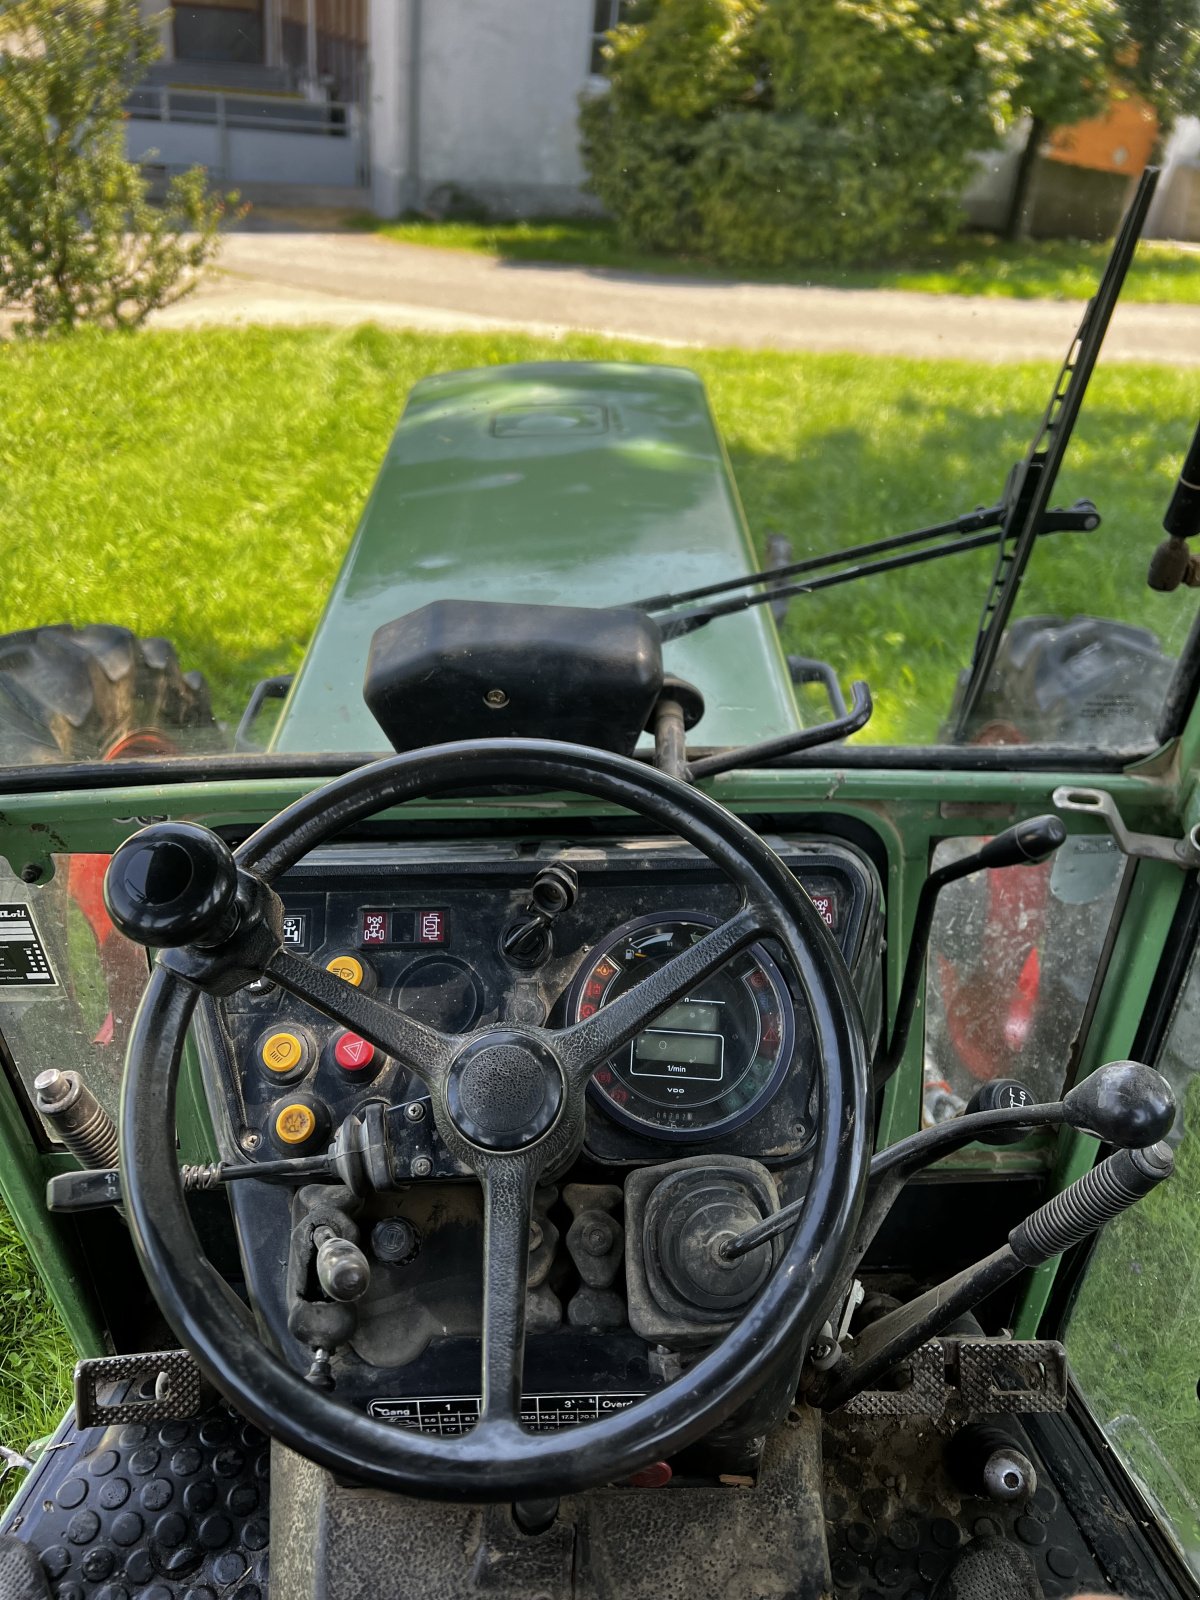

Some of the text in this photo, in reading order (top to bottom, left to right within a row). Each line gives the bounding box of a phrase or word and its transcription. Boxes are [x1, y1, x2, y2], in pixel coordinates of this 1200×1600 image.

[667, 1064, 686, 1073] 1/min
[1009, 1087, 1026, 1100] L S
[381, 1408, 410, 1416] Gang
[444, 1403, 451, 1411] 1
[564, 1400, 572, 1408] 3
